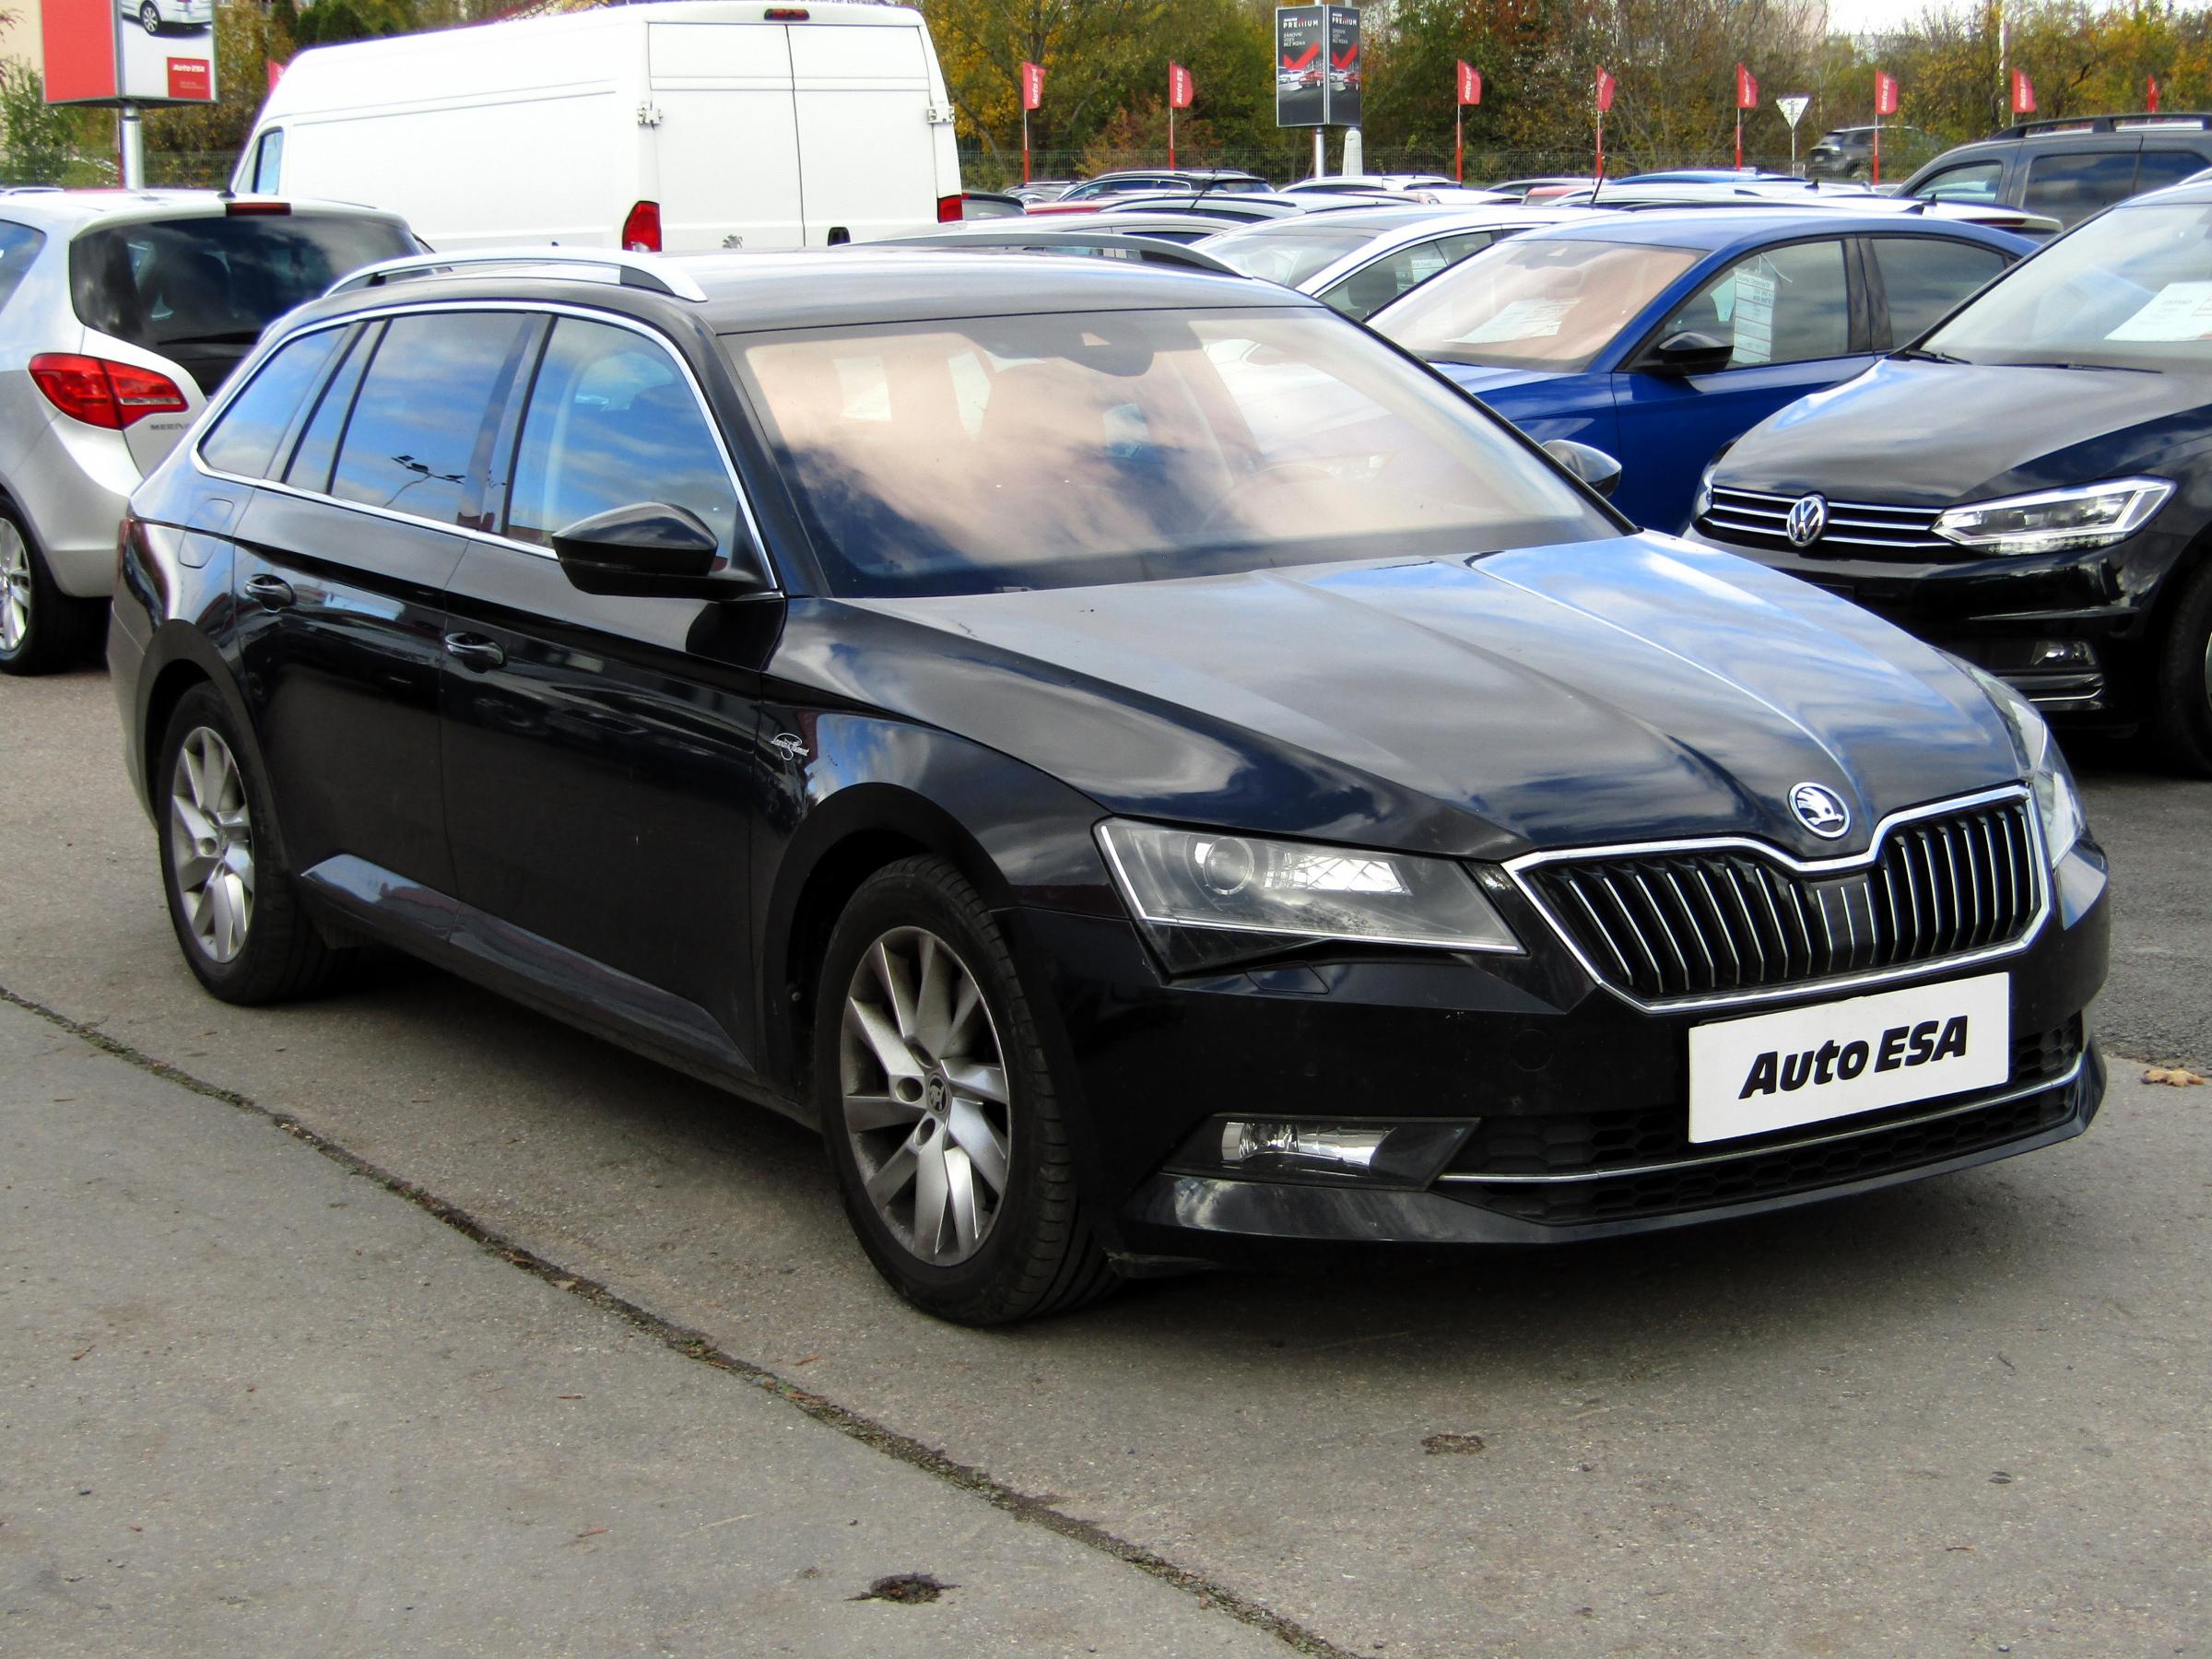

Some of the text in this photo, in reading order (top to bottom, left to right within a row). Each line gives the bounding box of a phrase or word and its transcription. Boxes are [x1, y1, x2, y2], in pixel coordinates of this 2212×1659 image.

[1283, 18, 1319, 29] PREMIUM
[1737, 1015, 1968, 1100] Auto ESA
